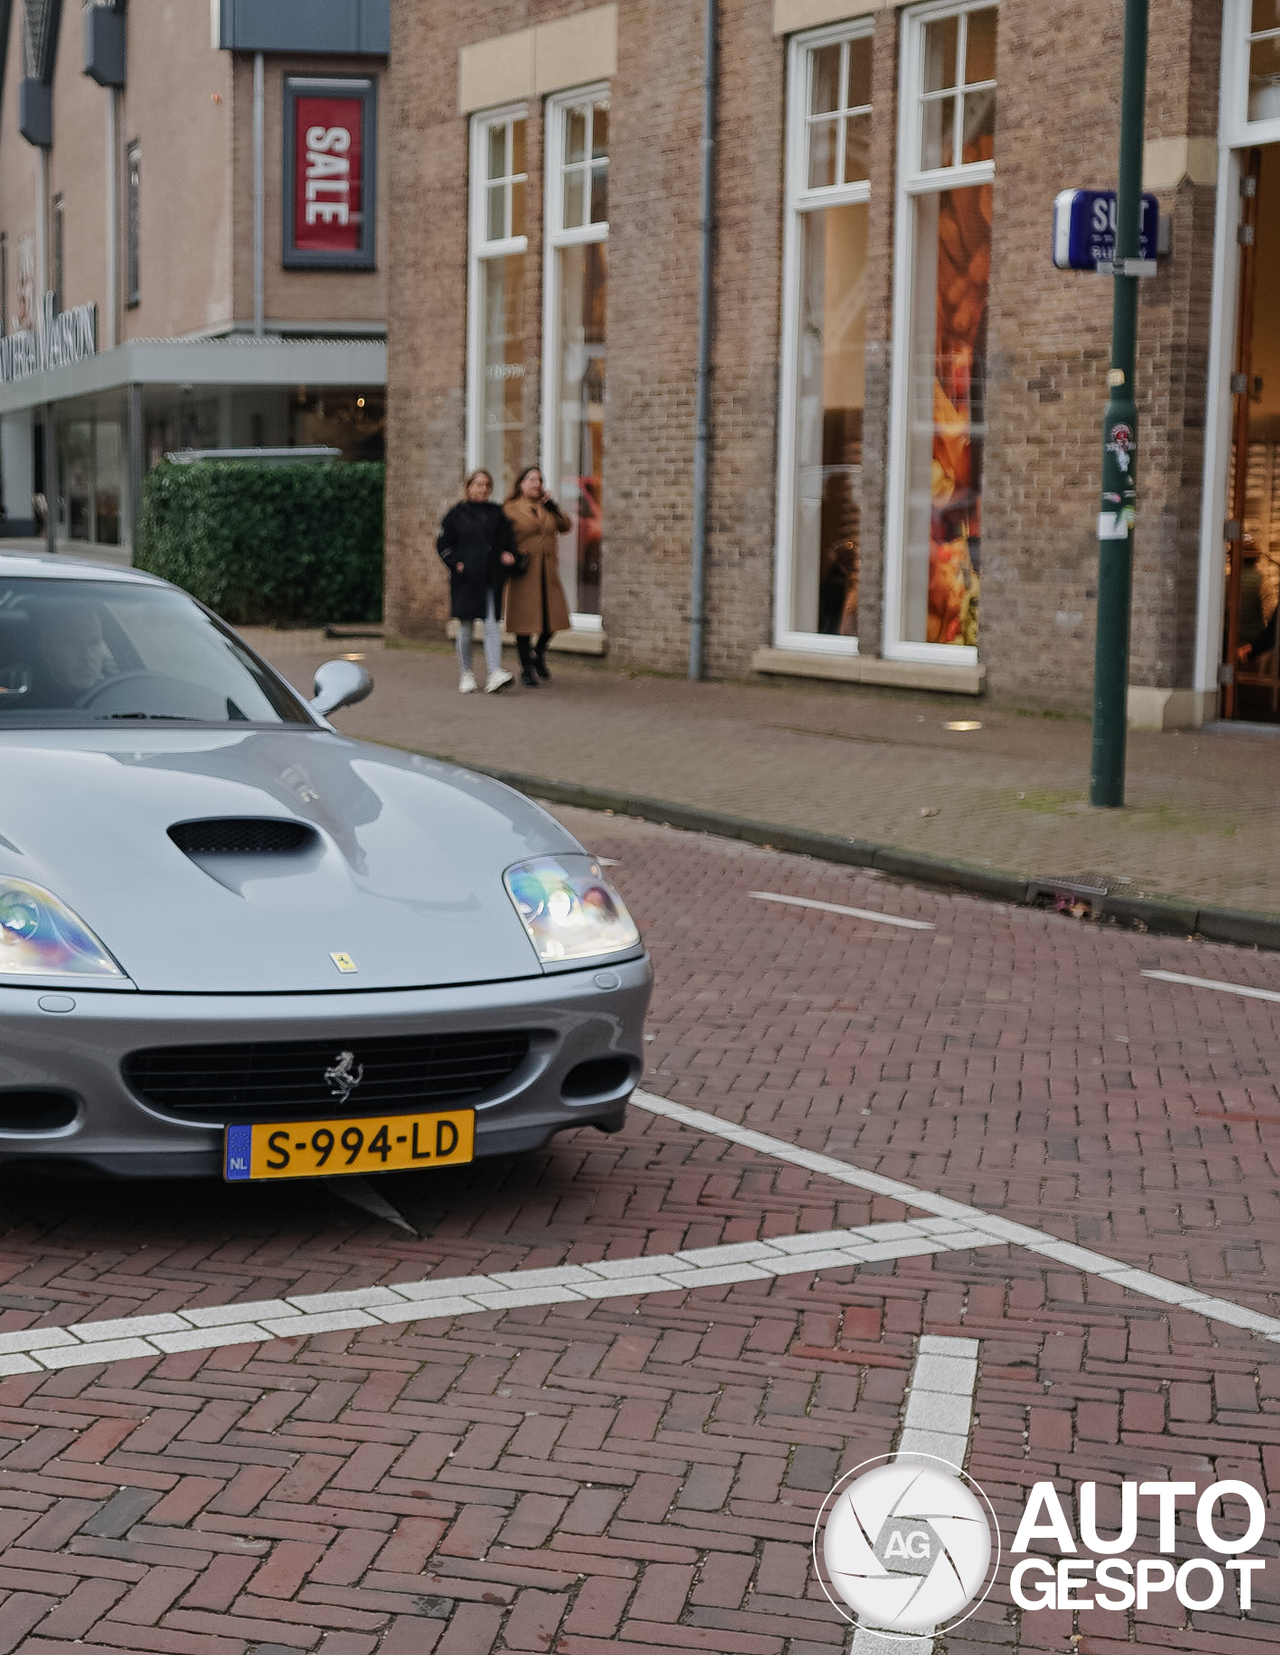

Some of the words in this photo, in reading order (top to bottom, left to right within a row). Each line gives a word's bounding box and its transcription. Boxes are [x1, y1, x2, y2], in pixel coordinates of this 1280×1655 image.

[305, 126, 352, 226] SALE
[1093, 197, 1150, 233] SUT
[229, 1157, 248, 1170] NL
[266, 1120, 459, 1169] S-994-LD
